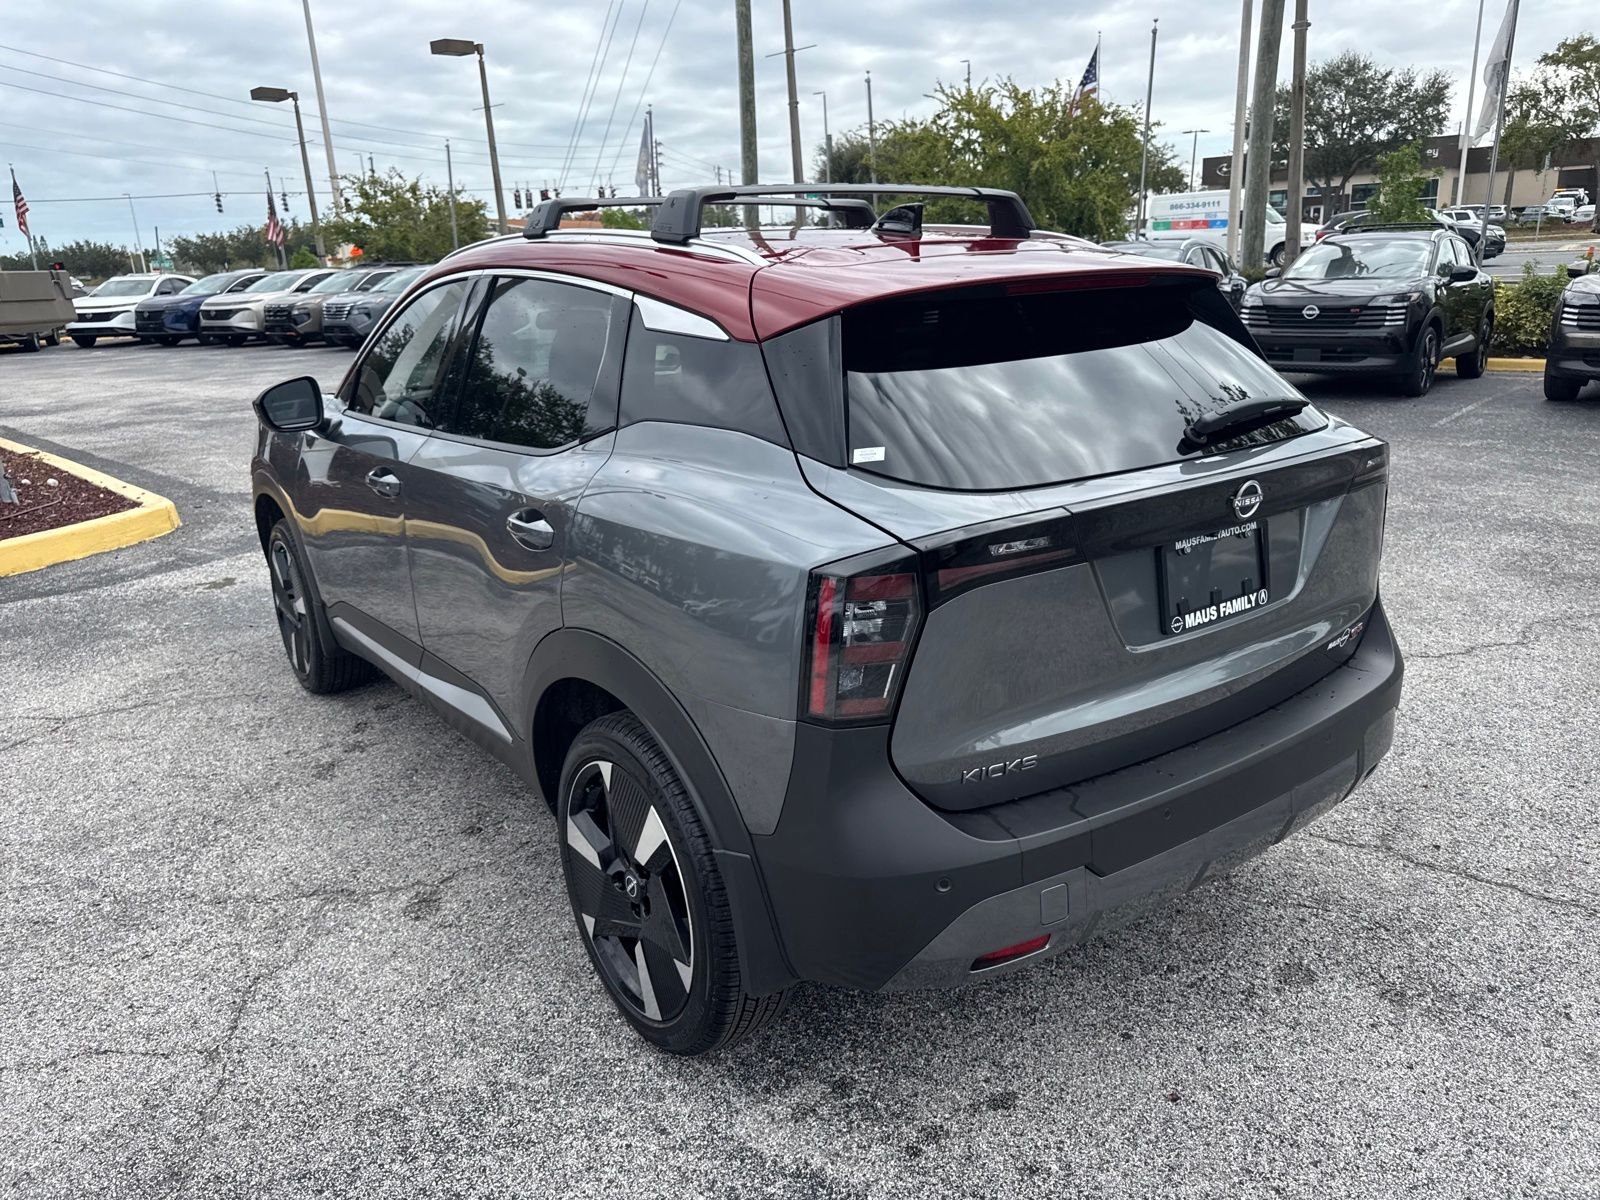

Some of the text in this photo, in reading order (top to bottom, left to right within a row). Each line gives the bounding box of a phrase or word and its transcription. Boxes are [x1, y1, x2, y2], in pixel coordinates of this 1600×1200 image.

[1169, 200, 1221, 210] 866-334-9111
[1234, 495, 1263, 507] NISSAN
[1175, 521, 1257, 550] MAUSFAMYAUTO.COM
[1185, 592, 1257, 629] MAUS FAMILY
[960, 754, 1038, 785] KICKS
